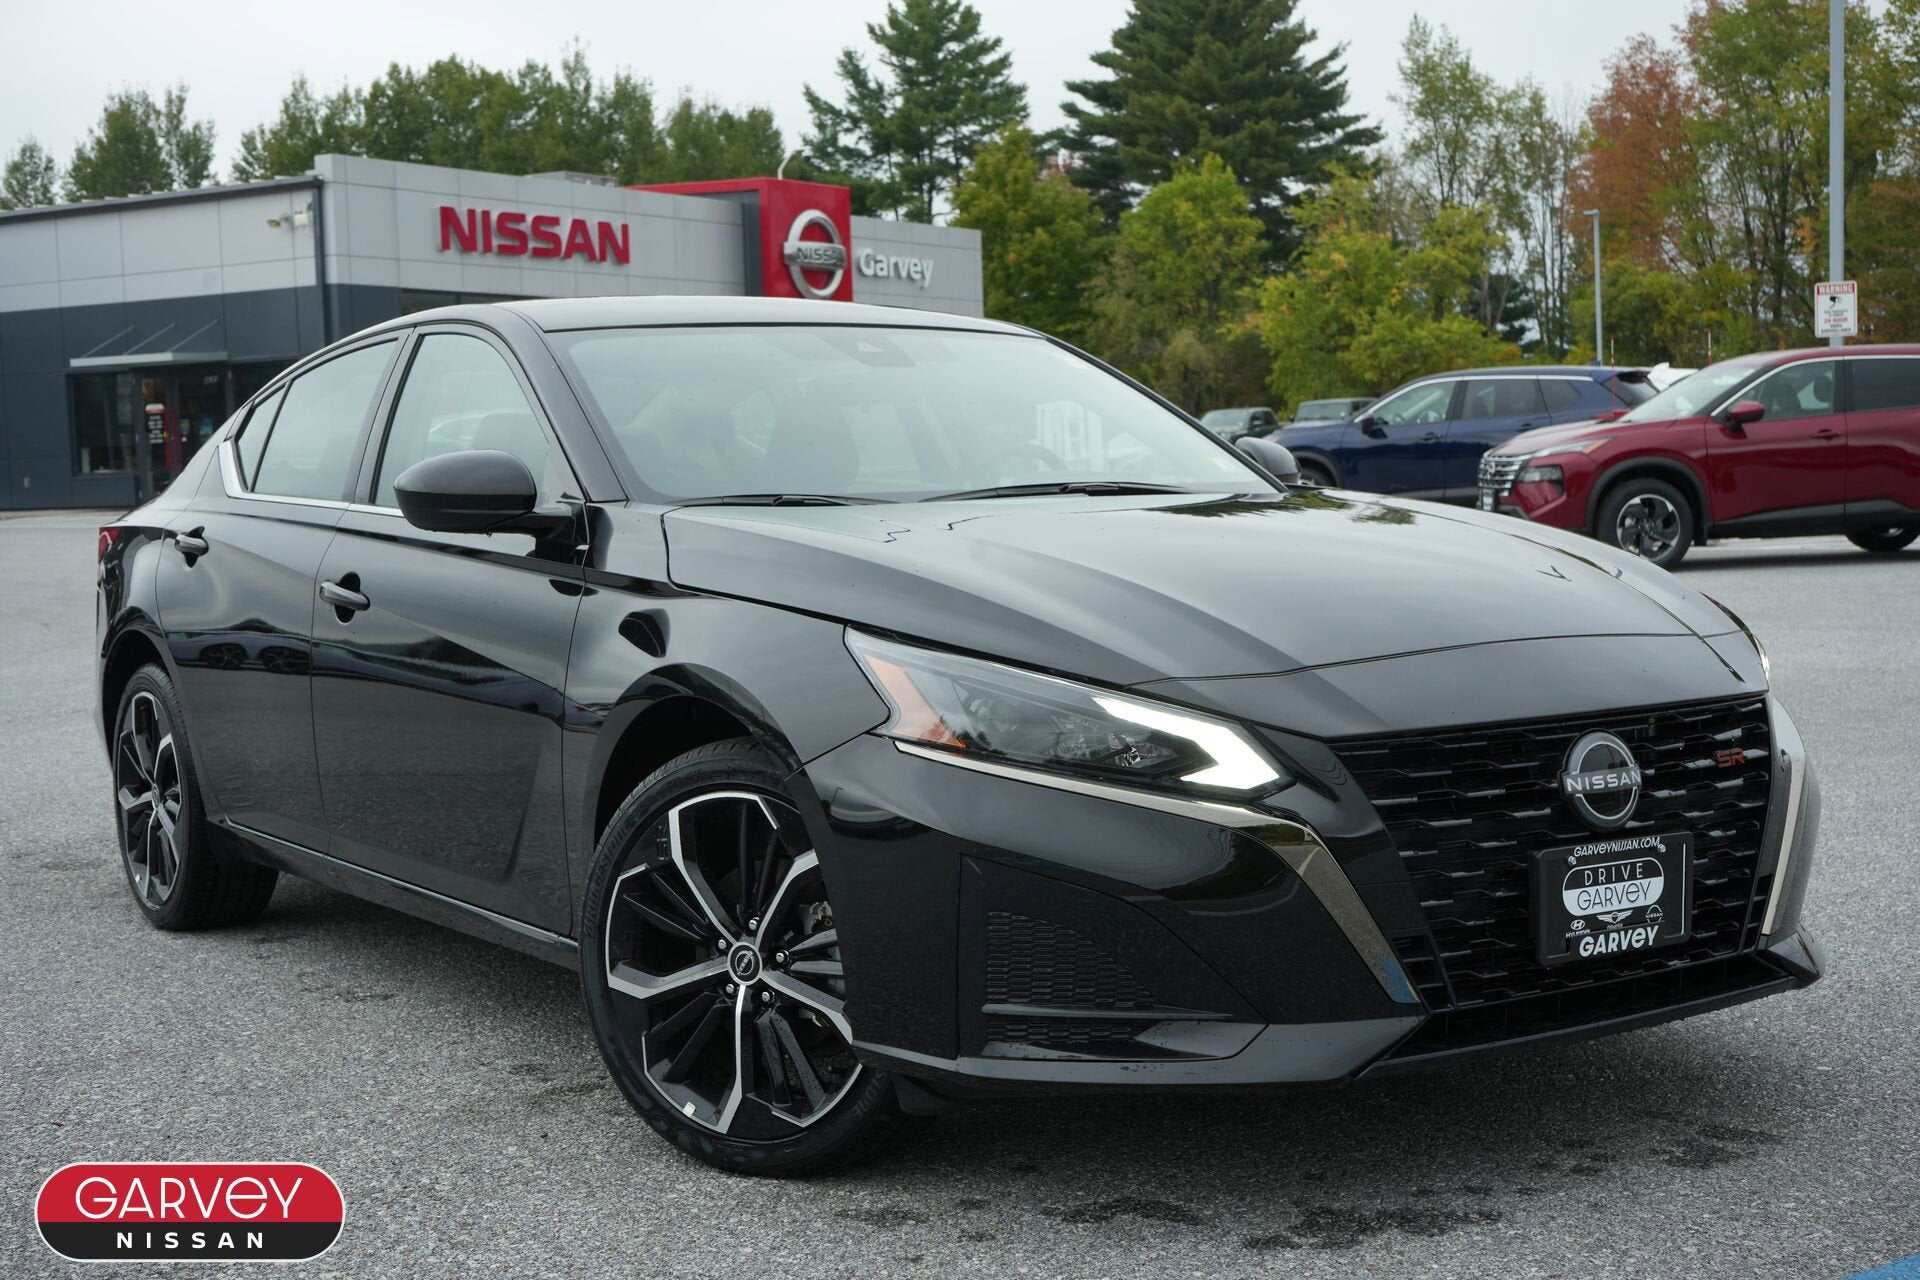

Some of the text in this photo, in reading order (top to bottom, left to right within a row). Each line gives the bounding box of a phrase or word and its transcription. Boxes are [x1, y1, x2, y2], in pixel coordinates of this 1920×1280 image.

[439, 206, 630, 264] NISSAN
[858, 247, 934, 288] Garvey
[1715, 748, 1745, 768] SR
[1566, 770, 1641, 793] NISSAN
[1584, 863, 1644, 886] DRIVE
